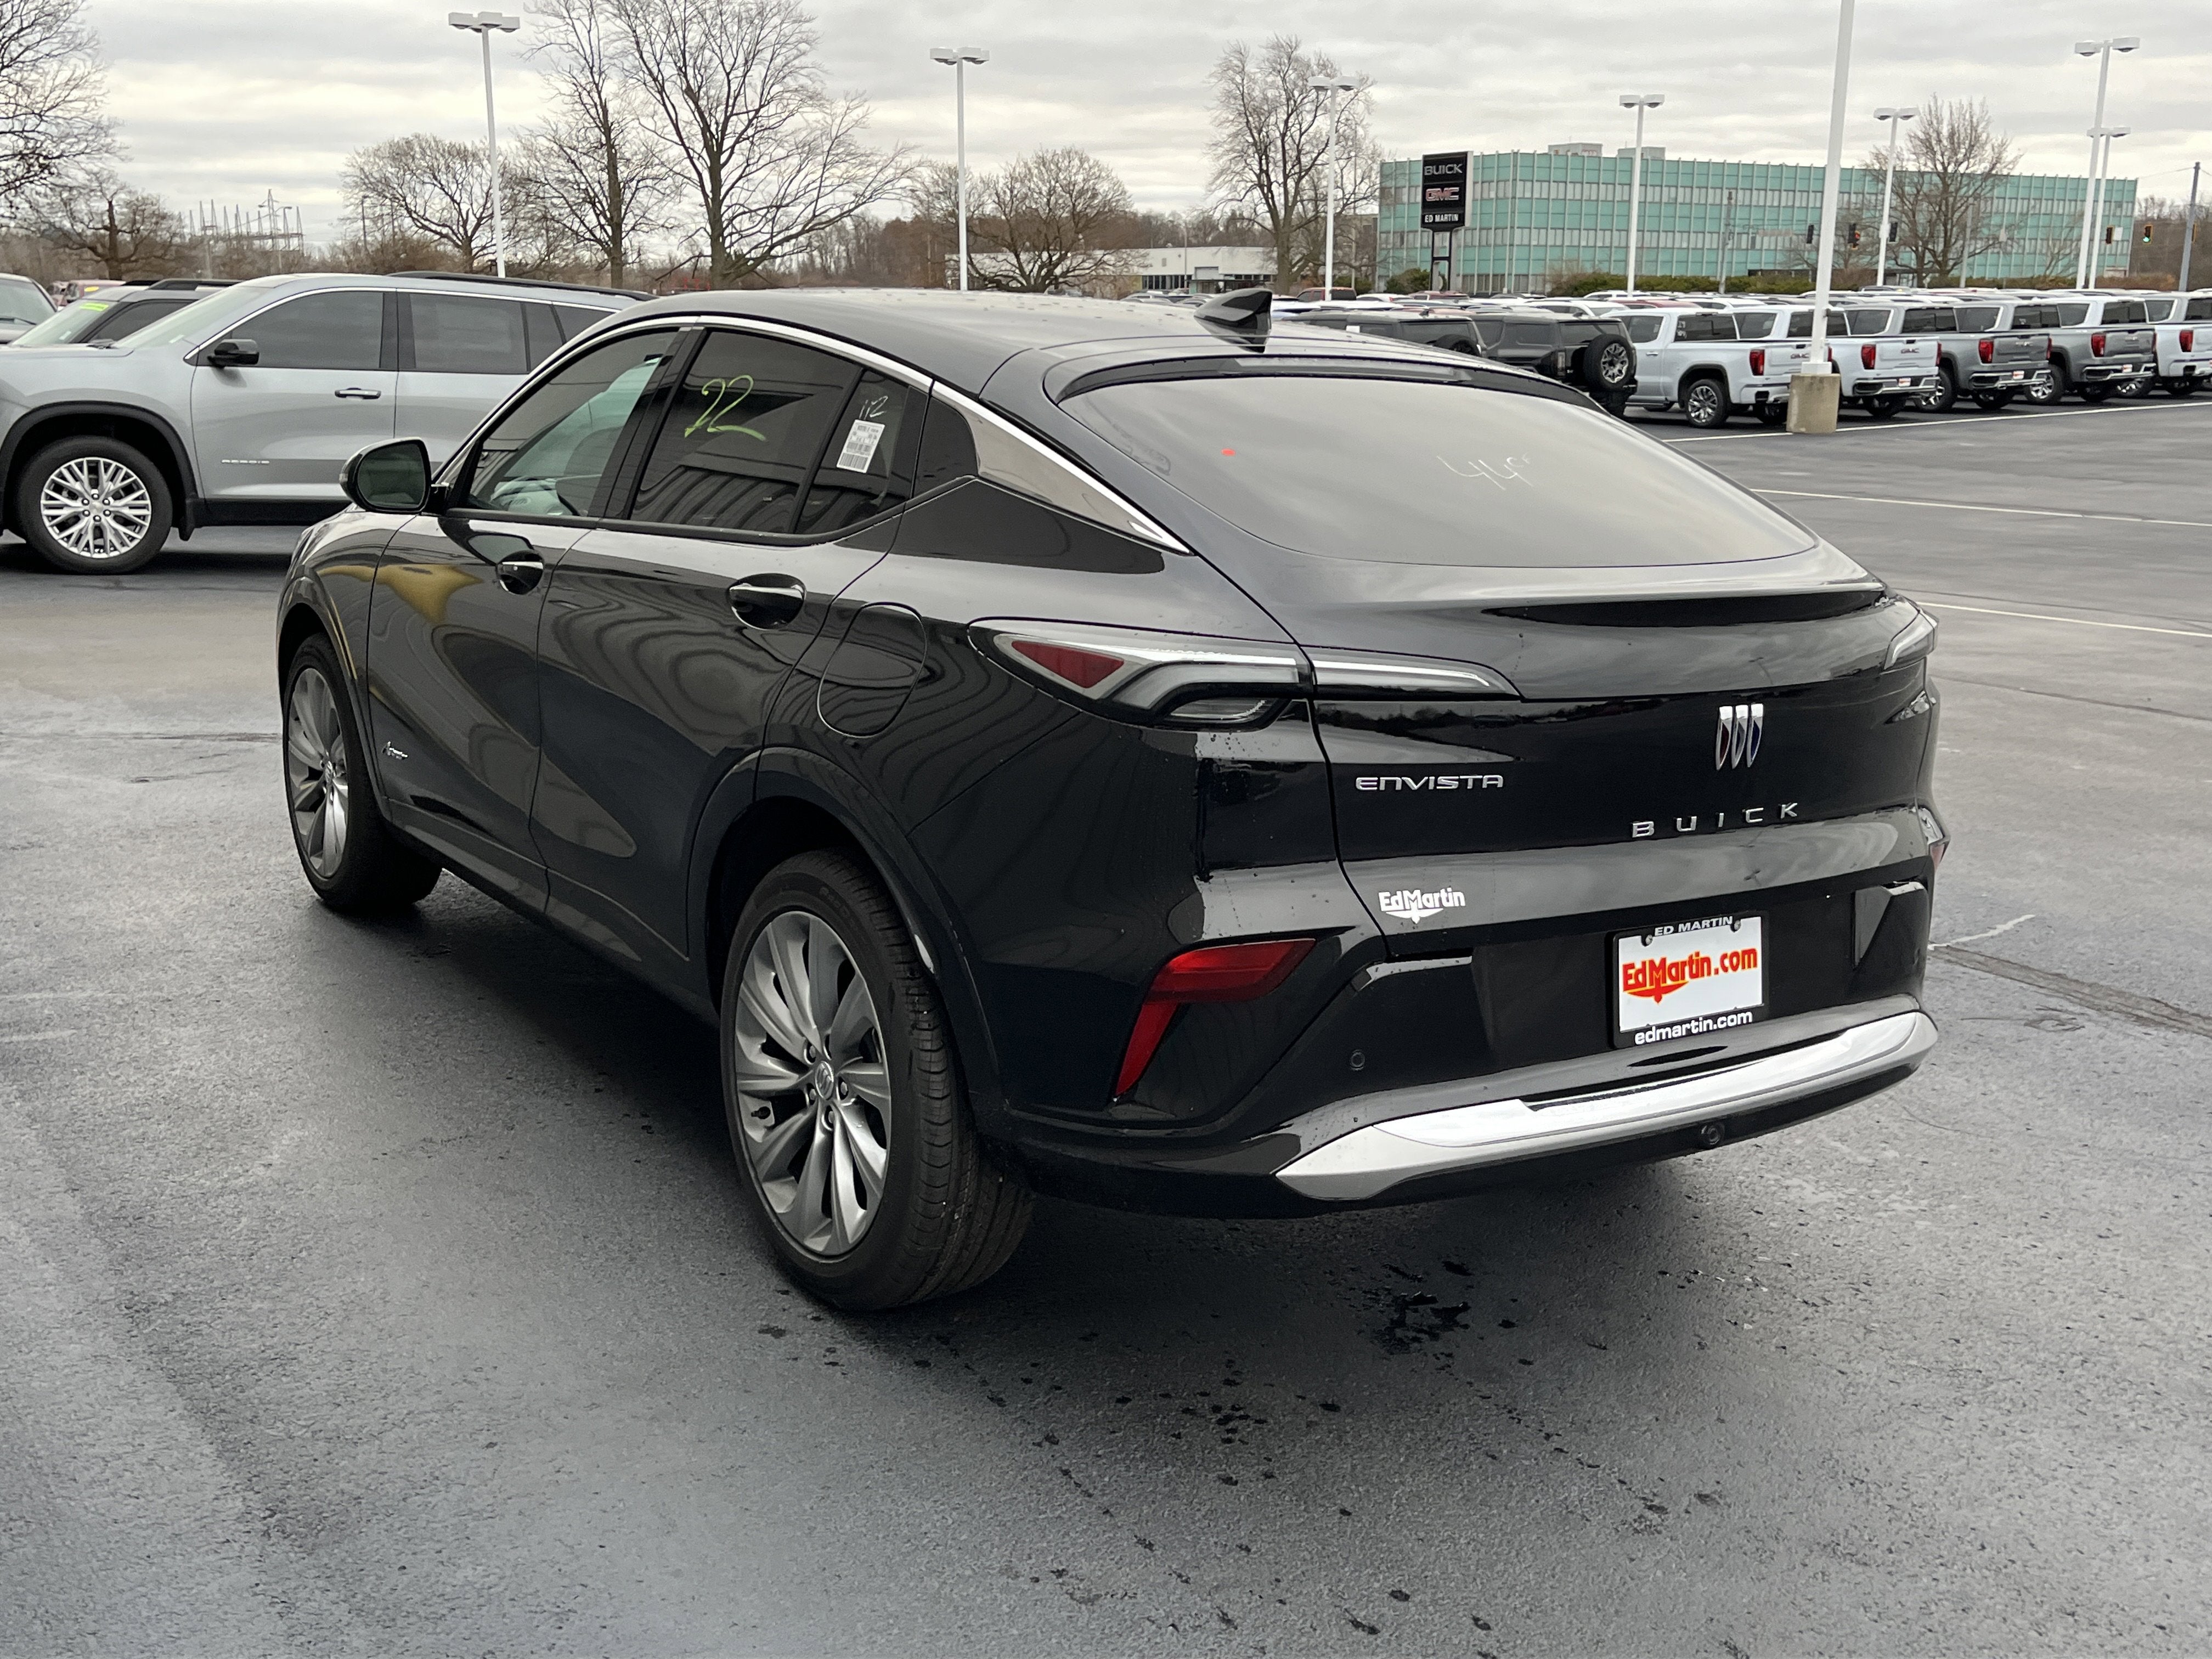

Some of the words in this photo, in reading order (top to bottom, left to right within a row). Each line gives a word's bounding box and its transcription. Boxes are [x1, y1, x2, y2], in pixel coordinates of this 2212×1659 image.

[1424, 164, 1463, 176] BUICK
[1426, 187, 1460, 201] GMC
[1425, 215, 1434, 223] ED
[1435, 214, 1459, 222] MARTIN
[685, 375, 766, 440] 22
[1356, 775, 1504, 790] ENVISTA
[1632, 802, 1798, 838] BUICK
[1378, 887, 1466, 911] EdMartin
[1655, 926, 1674, 936] ED
[1678, 916, 1733, 933] MARTIN
[1622, 948, 1758, 992] EdMartin.com
[1635, 1011, 1753, 1045] edmartin.com
